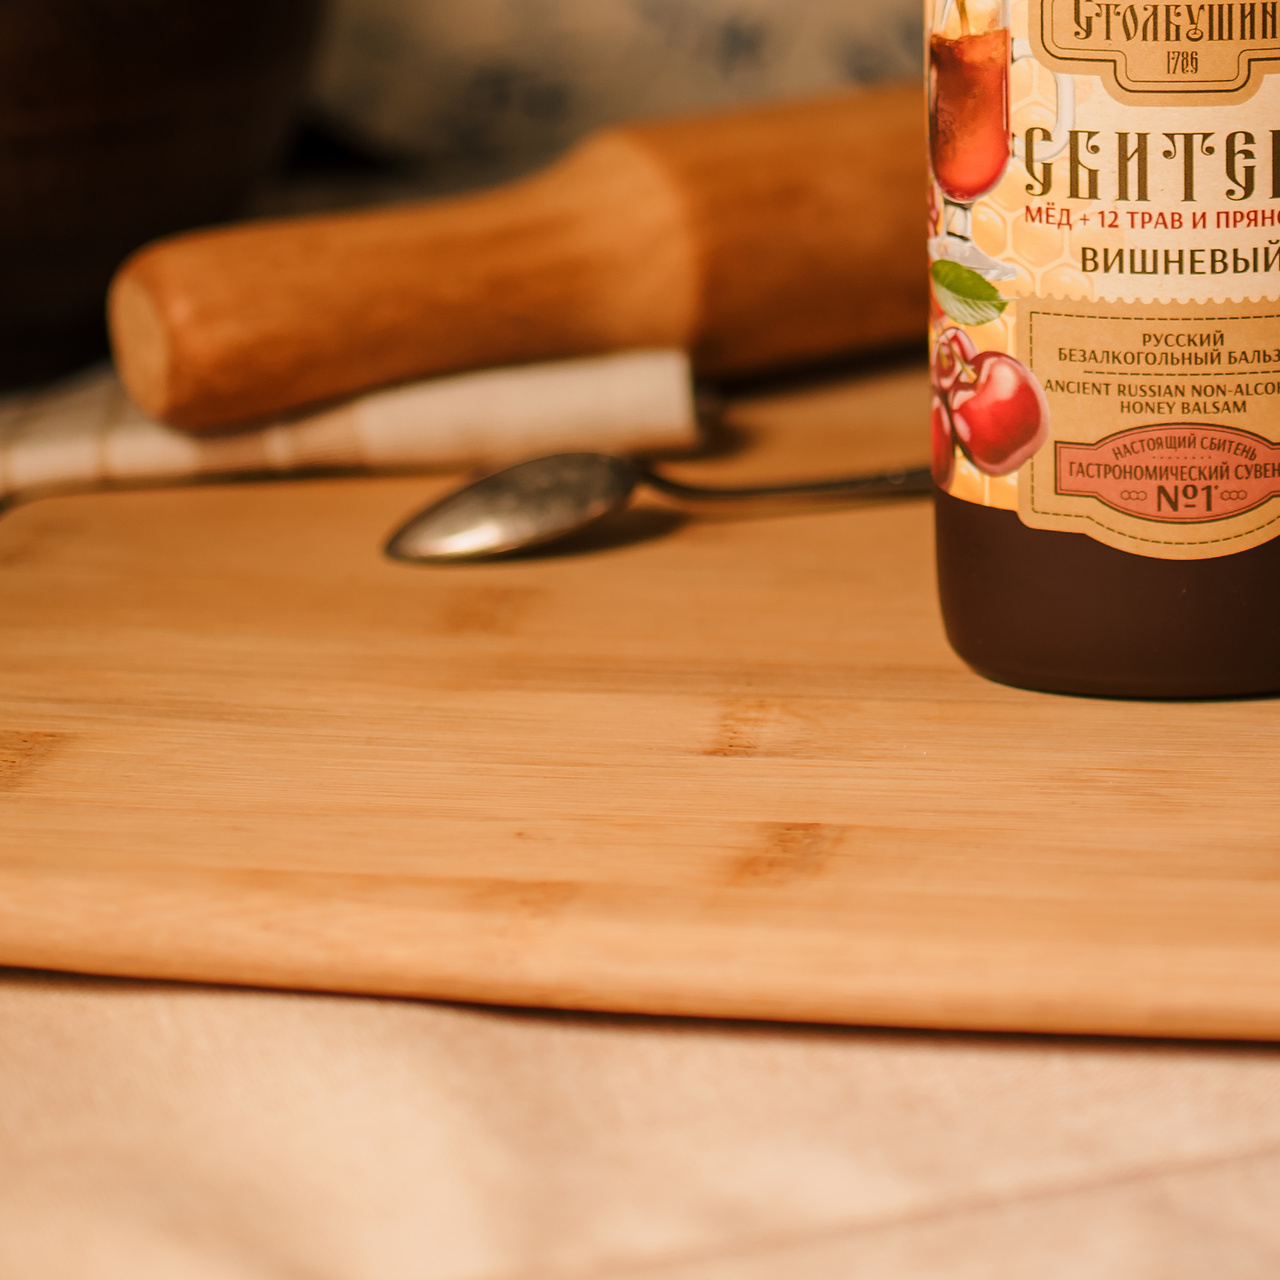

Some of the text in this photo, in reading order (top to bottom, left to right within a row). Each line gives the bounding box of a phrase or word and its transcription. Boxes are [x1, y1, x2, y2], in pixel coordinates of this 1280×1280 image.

[1166, 50, 1199, 74] 1786
[1025, 202, 1073, 230] МЁД
[1101, 210, 1119, 228] 12
[1126, 211, 1183, 230] ТРАВ
[1192, 211, 1207, 229] И
[1142, 330, 1225, 348] РУССКИЙ
[1058, 347, 1221, 366] БЕЗАЛКОГОЛЬНЫЙ
[1044, 379, 1110, 396] ANCIENT
[1117, 383, 1186, 398] RUSSIAN
[1120, 400, 1247, 415] HONEY BALSAM
[1112, 433, 1258, 461] НАСТОЯЩИЙ СБИТЕНЬ
[1069, 461, 1230, 481] ГАСТРОНОМИЧЕСКИЙ
